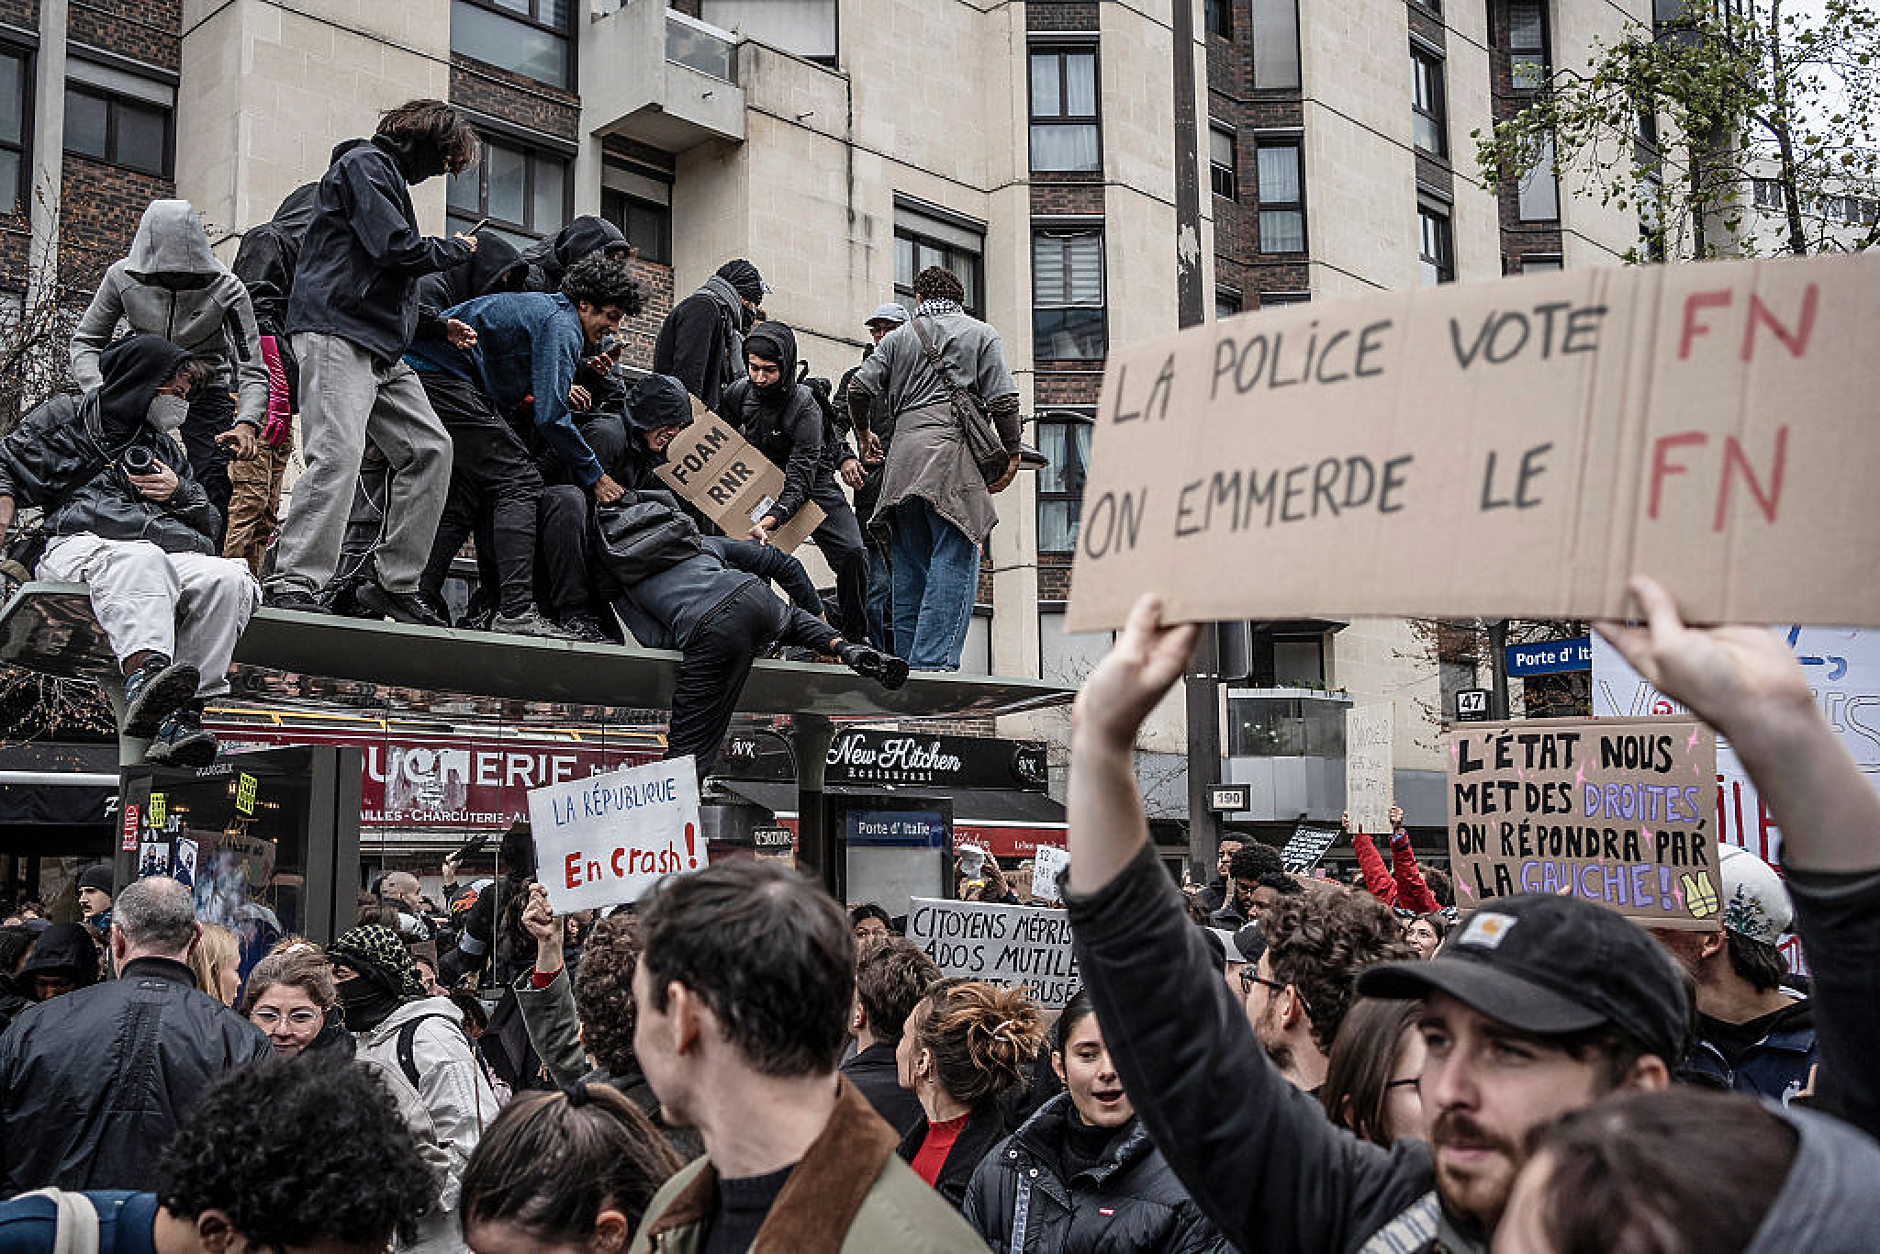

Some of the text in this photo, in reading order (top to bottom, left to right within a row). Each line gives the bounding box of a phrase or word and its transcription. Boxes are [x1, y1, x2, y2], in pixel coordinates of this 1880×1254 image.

[1113, 352, 1175, 423] LA
[1449, 302, 1609, 370] VOTE
[1677, 283, 1819, 363] FN
[671, 426, 729, 485] FOAM
[707, 461, 755, 505] RNR
[1084, 425, 1788, 560] ON EMMERDE LE FN
[1516, 651, 1556, 667] Porte
[1578, 646, 1592, 660] It
[1461, 693, 1482, 709] 47
[826, 734, 961, 771] New Kitchen
[1458, 729, 1673, 775] L'ÉTAT NOUS
[552, 781, 677, 827] LA RÉPUBLIQUE
[858, 822, 888, 835] Porte
[1457, 822, 1486, 855] ON
[1501, 818, 1642, 862] RÉPONDRA
[564, 851, 603, 889] En
[1473, 862, 1514, 899] LA
[913, 907, 1007, 939] CITOYENS
[923, 940, 985, 972] ADOS
